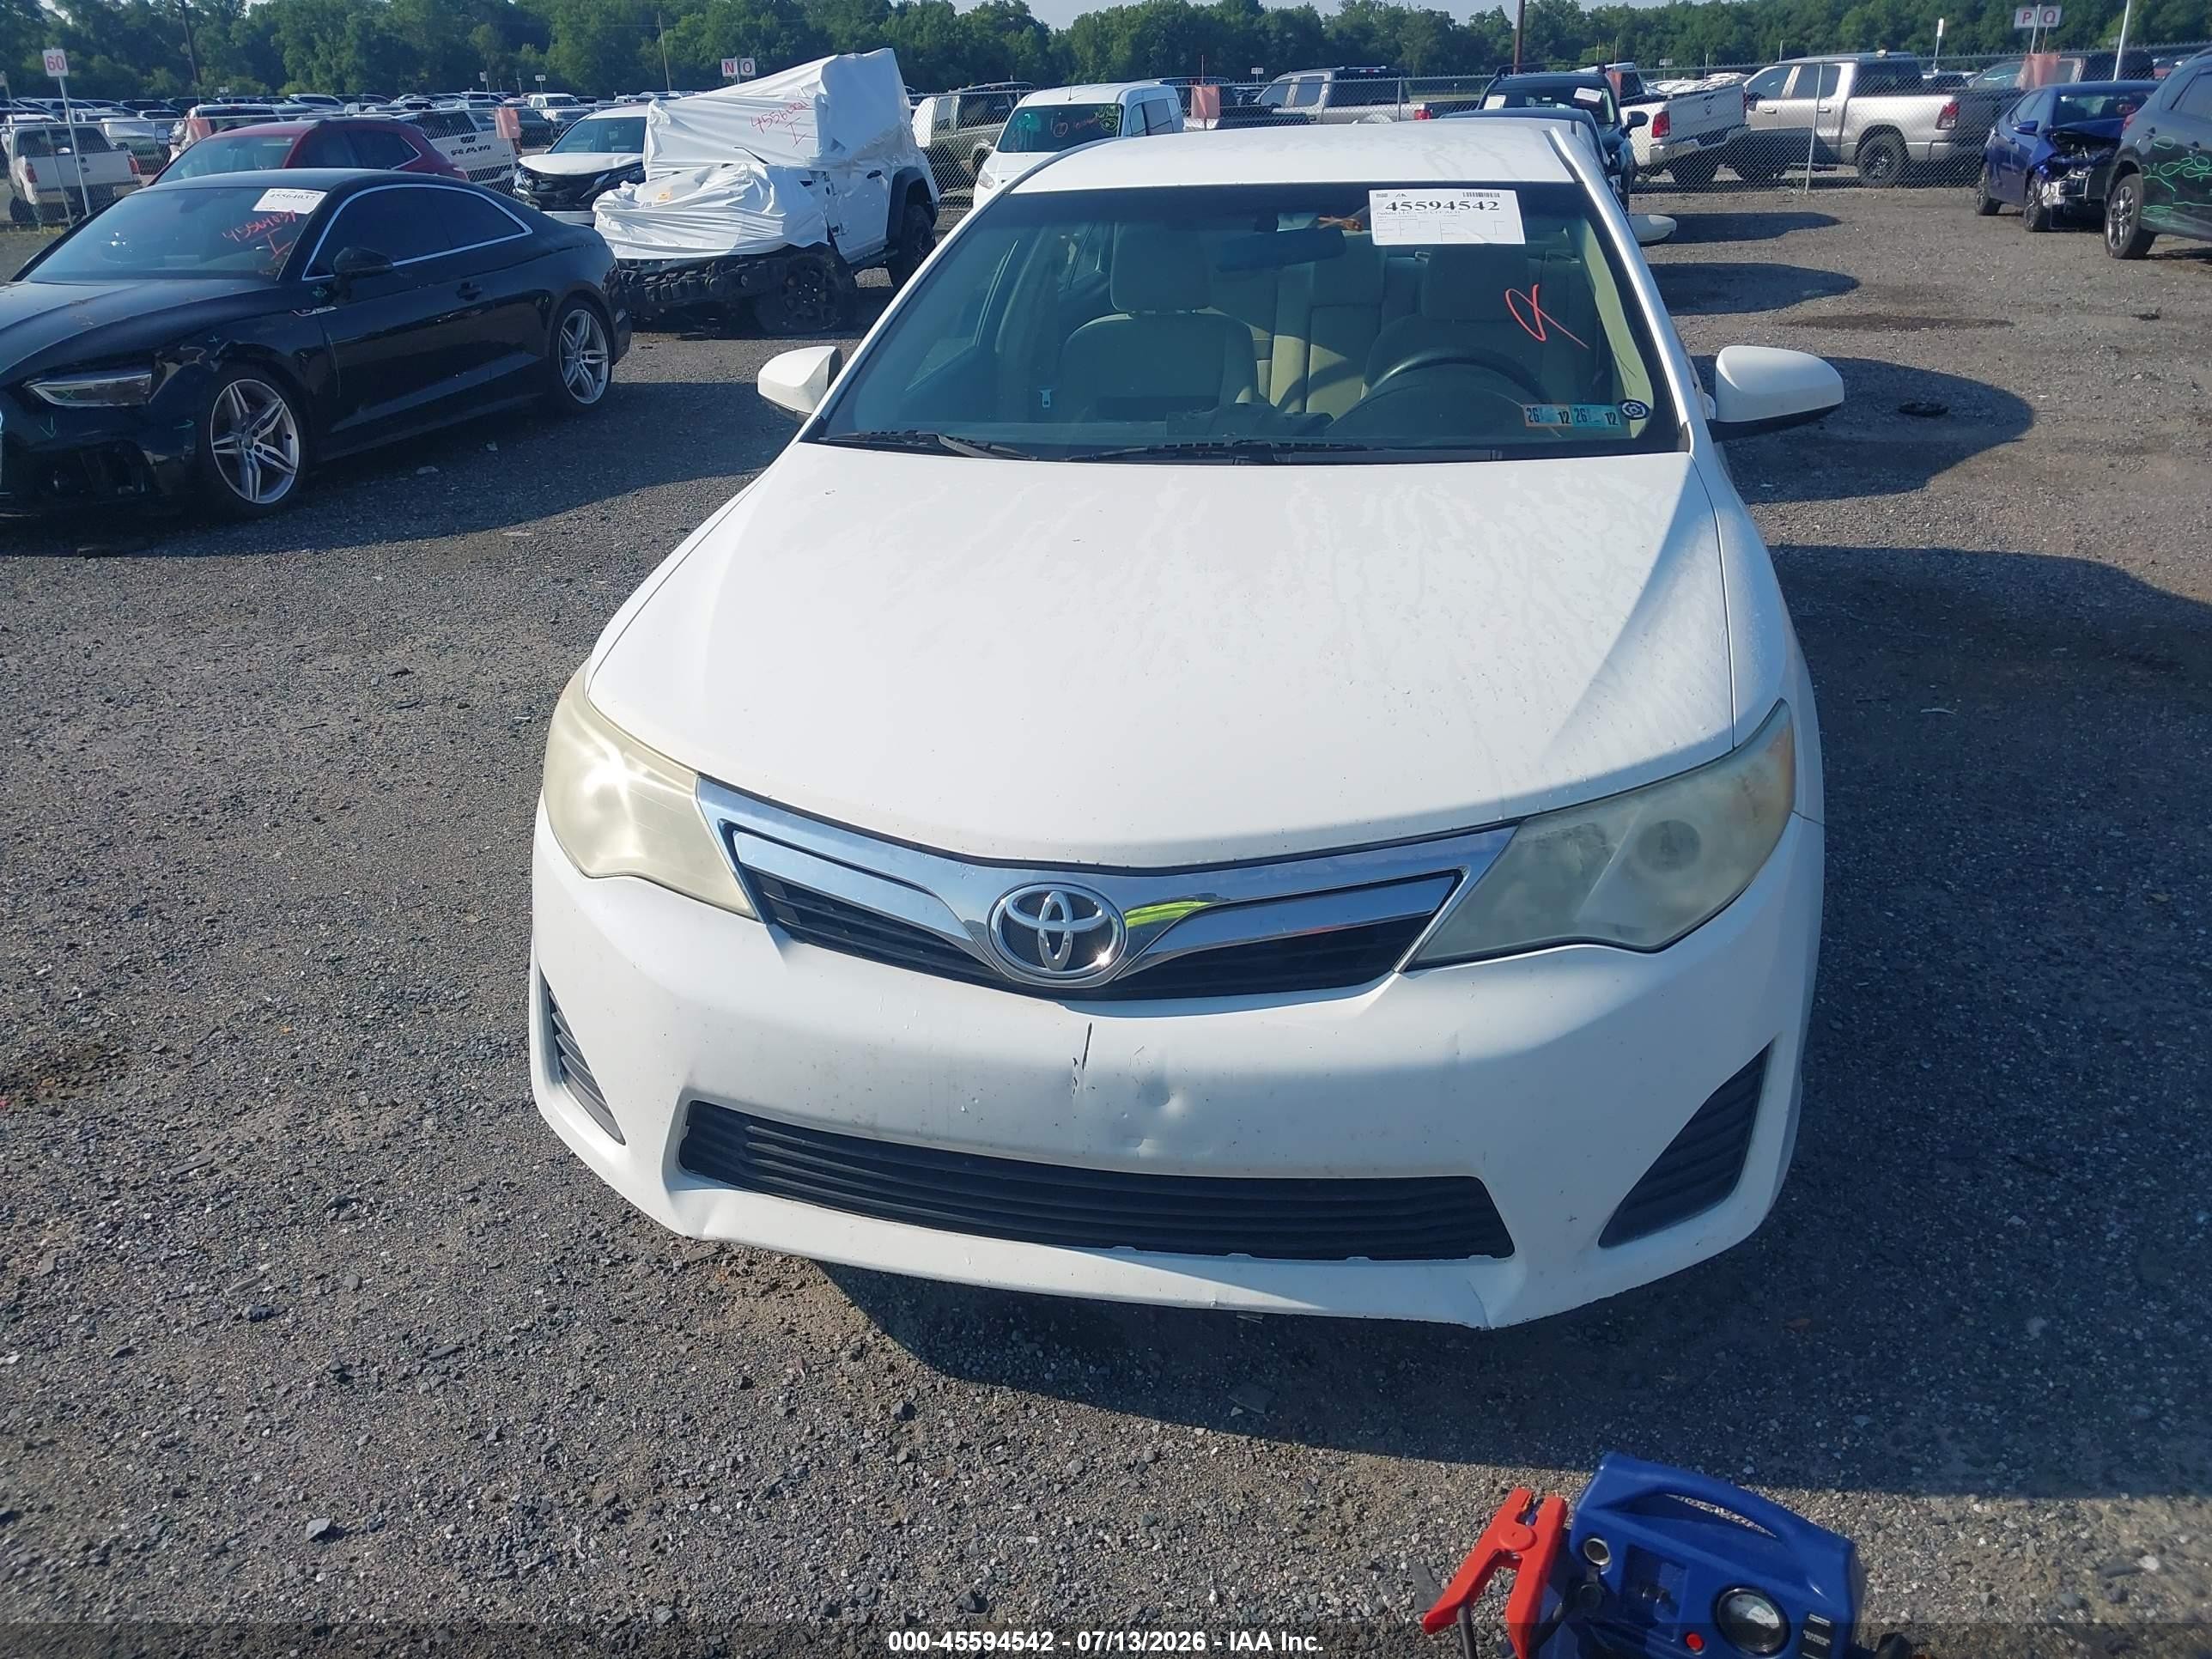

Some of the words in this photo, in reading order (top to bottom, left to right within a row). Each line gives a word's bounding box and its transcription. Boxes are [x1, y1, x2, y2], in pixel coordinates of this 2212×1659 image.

[2022, 11, 2033, 24] P
[2044, 9, 2056, 24] Q
[47, 55, 64, 70] 60
[725, 62, 735, 74] N
[1385, 200, 1500, 211] 45594542
[1526, 405, 1540, 423] 26
[1558, 410, 1572, 424] 12
[1574, 407, 1588, 423] 26
[1604, 411, 1619, 426] 12
